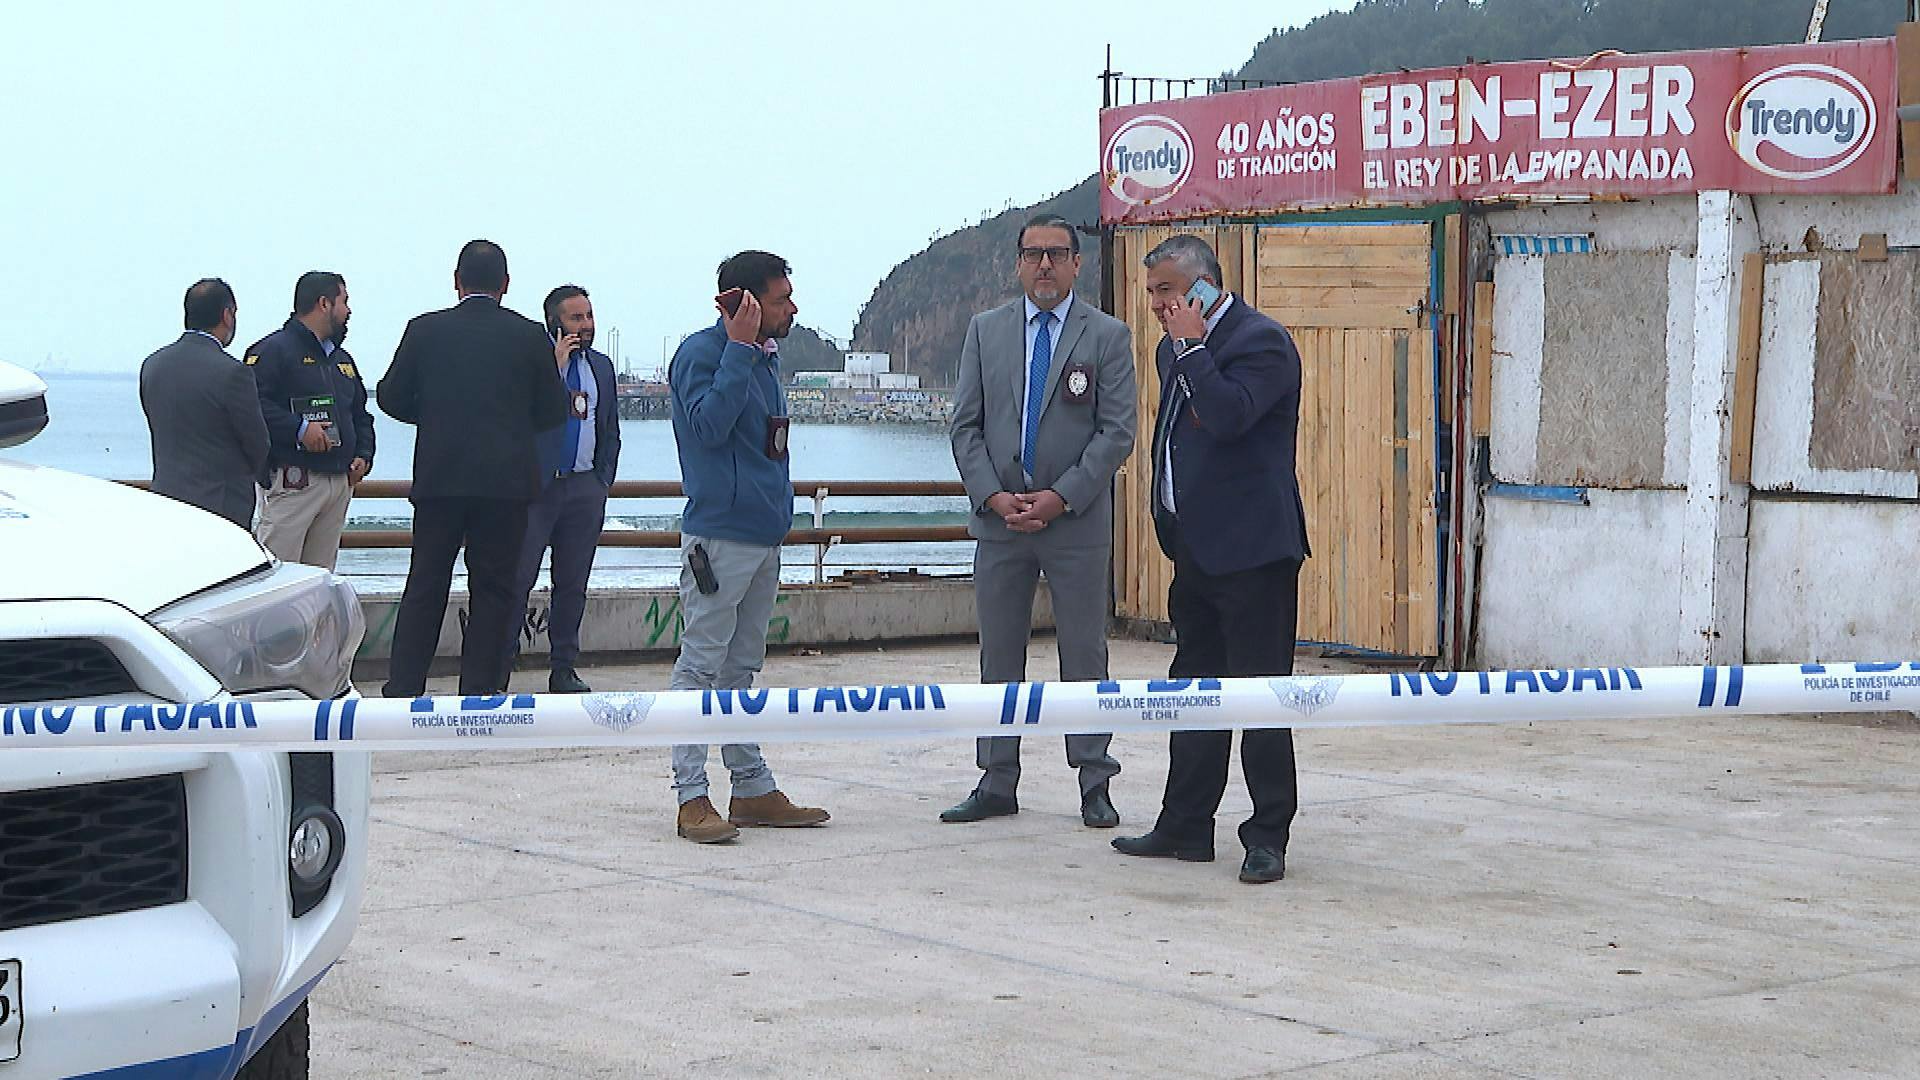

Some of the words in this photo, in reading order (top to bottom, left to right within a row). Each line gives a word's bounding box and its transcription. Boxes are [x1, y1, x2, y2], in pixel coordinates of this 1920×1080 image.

[1361, 65, 1696, 150] EBEN-EZER
[1216, 122, 1250, 154] 40
[1255, 107, 1336, 151] AÑOS
[1747, 98, 1855, 143] Trendy
[1114, 139, 1182, 175] Trendy
[1217, 158, 1236, 179] DE
[1240, 144, 1337, 177] TRADICIÓN
[1362, 160, 1389, 189] EL
[1394, 157, 1442, 188] REY
[1450, 154, 1481, 186] DE
[1488, 152, 1520, 184] LA
[1522, 147, 1695, 184] EMPANADA
[1804, 676, 1840, 690] POLICÍA
[1841, 677, 1855, 689] DE
[1099, 695, 1132, 710] POLICÍA
[1133, 698, 1145, 709] DE
[1146, 695, 1222, 709] INVESTIGACIONES
[1850, 691, 1863, 703] DE
[1864, 689, 1891, 702] CHILE
[412, 714, 445, 728] POLICÍA
[446, 715, 459, 727] DE
[460, 713, 535, 727] INVESTIGACIONES
[1141, 711, 1154, 721] DE
[1155, 709, 1180, 721] CHILE
[456, 728, 469, 737] DE
[470, 727, 494, 737] CHILE
